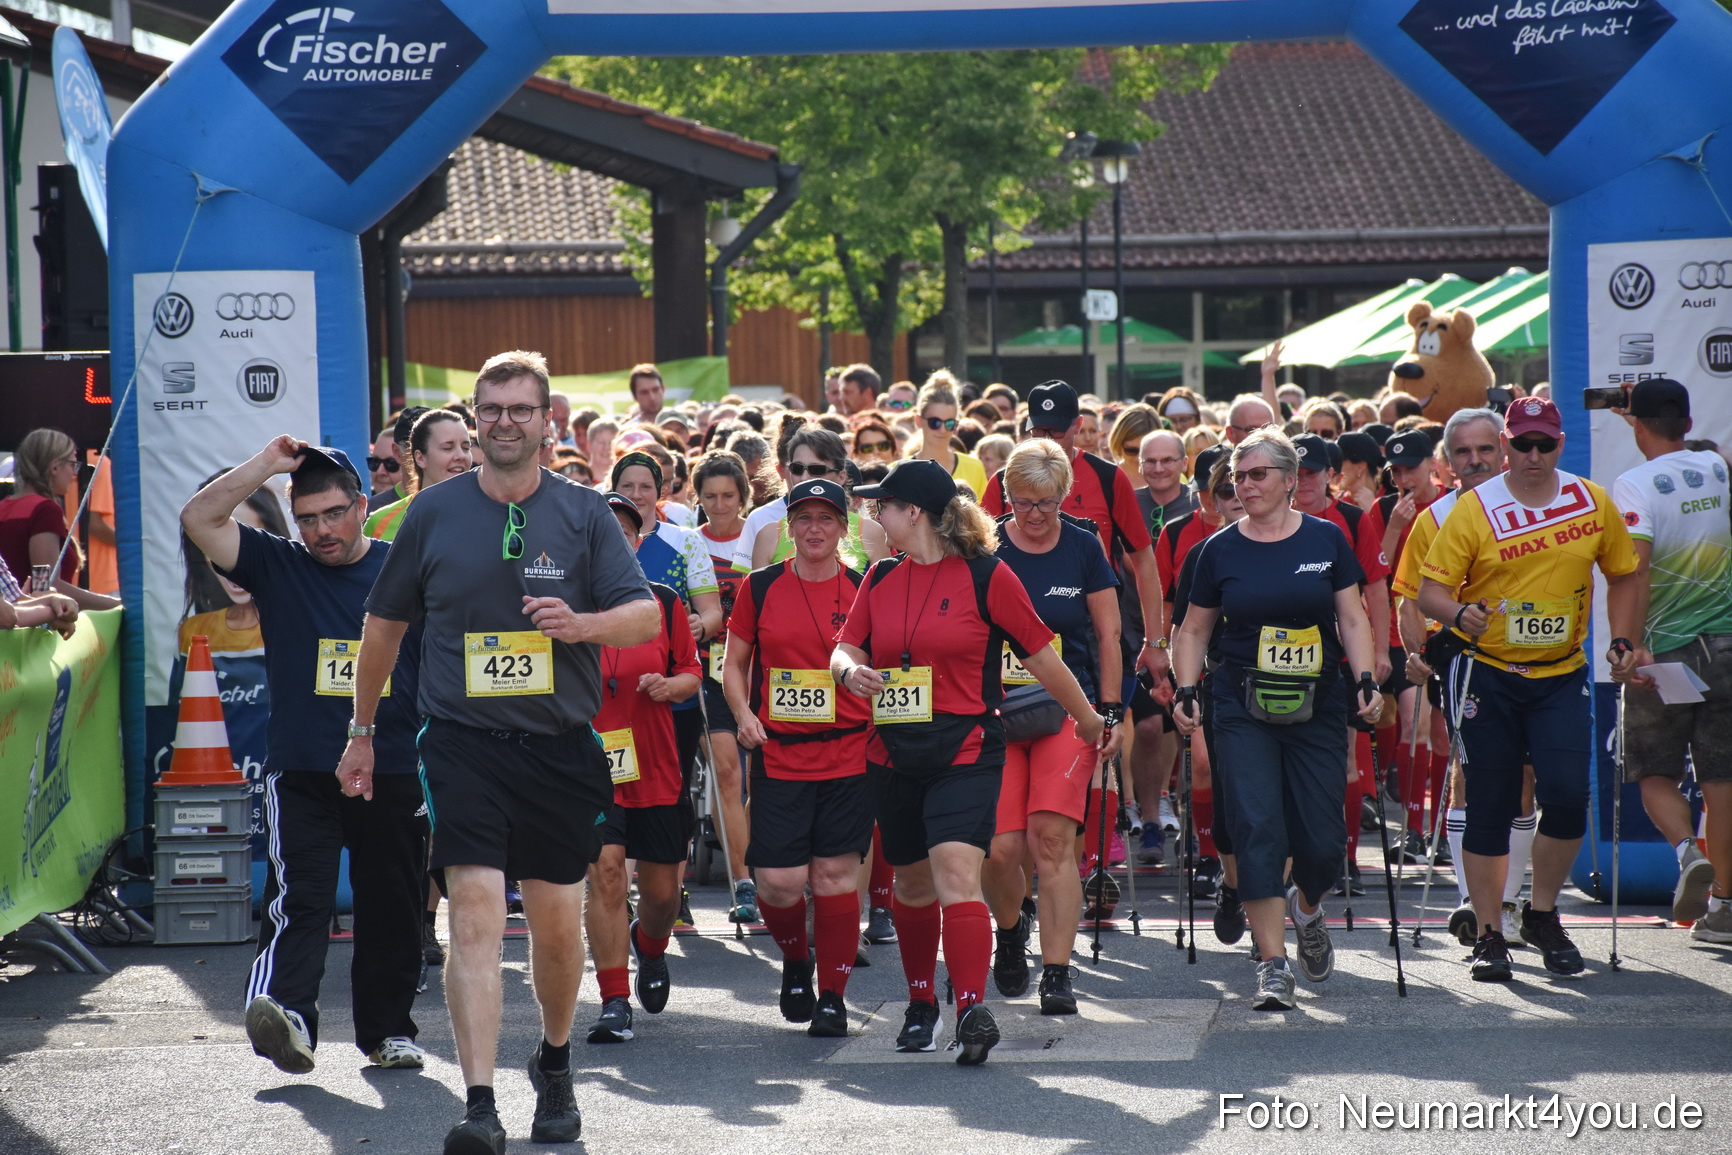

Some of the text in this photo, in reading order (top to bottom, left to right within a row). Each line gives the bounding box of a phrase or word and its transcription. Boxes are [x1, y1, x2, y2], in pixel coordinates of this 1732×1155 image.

[1457, 4, 1499, 30] und
[1505, 0, 1547, 20] das
[1513, 16, 1633, 55] fährt mit!
[289, 34, 447, 64] Fischer
[303, 69, 433, 82] AUTOMOBILE
[1681, 298, 1716, 309] Audi
[219, 329, 253, 339] Audi
[1710, 341, 1732, 364] FIA
[249, 373, 276, 394] FIAT
[1608, 372, 1667, 384] SEAT
[153, 400, 208, 411] SEAT
[1680, 495, 1721, 515] CREW
[1499, 520, 1604, 562] MAX BÖGL
[524, 567, 565, 577] BURKHARDT
[940, 598, 949, 611] 8
[831, 612, 847, 625] 24
[1515, 617, 1565, 635] 1662
[1267, 644, 1314, 665] 1411
[327, 660, 354, 680] 14
[483, 655, 533, 678] 423
[775, 688, 826, 708] 2358
[877, 687, 920, 709] 2331
